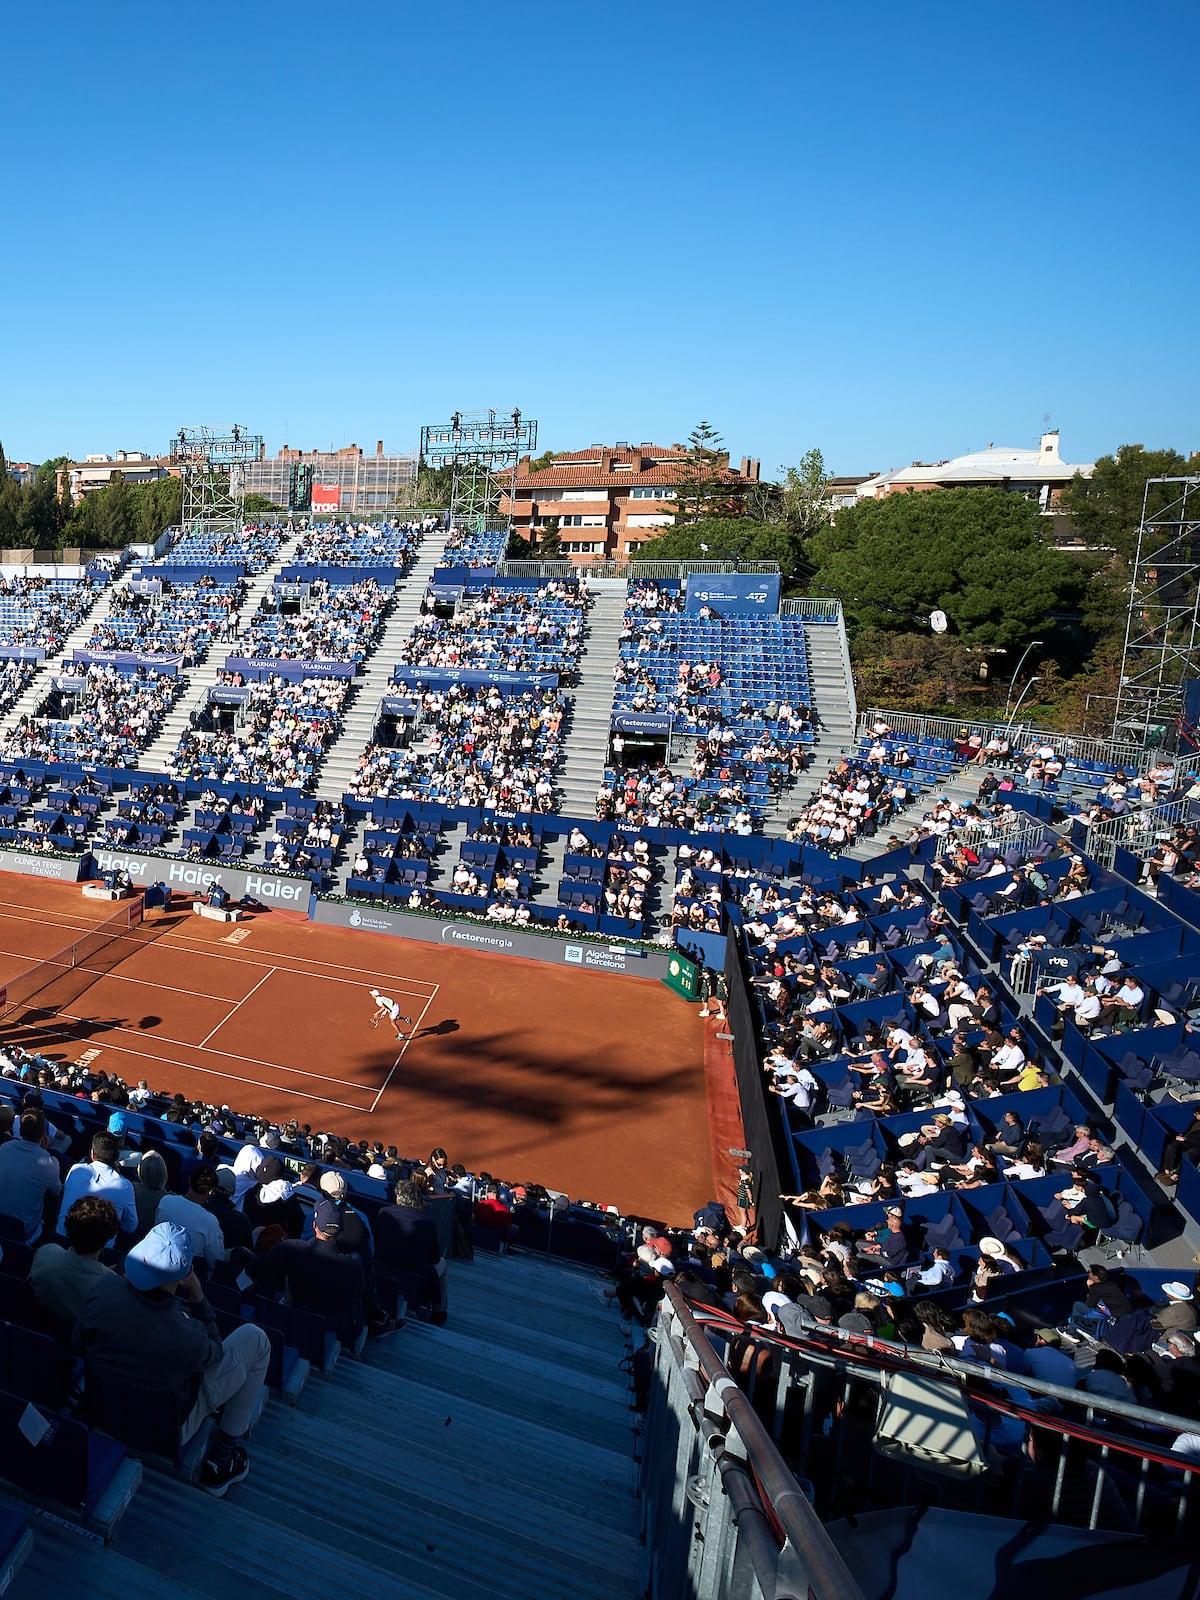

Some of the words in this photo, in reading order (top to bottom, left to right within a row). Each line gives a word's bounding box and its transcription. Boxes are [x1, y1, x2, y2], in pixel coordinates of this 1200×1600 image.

[745, 592, 768, 600] ATP
[622, 720, 668, 729] factorenergia
[265, 785, 284, 793] Haier
[354, 795, 374, 803] Haier
[494, 810, 517, 819] Haier
[617, 823, 642, 833] Haier
[14, 855, 41, 867] CLÍNICA
[42, 860, 62, 870] TENIS
[97, 853, 148, 876] Haier
[31, 866, 62, 877] TEKNON
[169, 863, 222, 887] Haier
[245, 875, 303, 901] Haier
[452, 930, 513, 947] factorenergia
[586, 949, 614, 961] Aigües
[586, 956, 626, 969] Barcelona
[73, 1048, 103, 1068] ELONA
